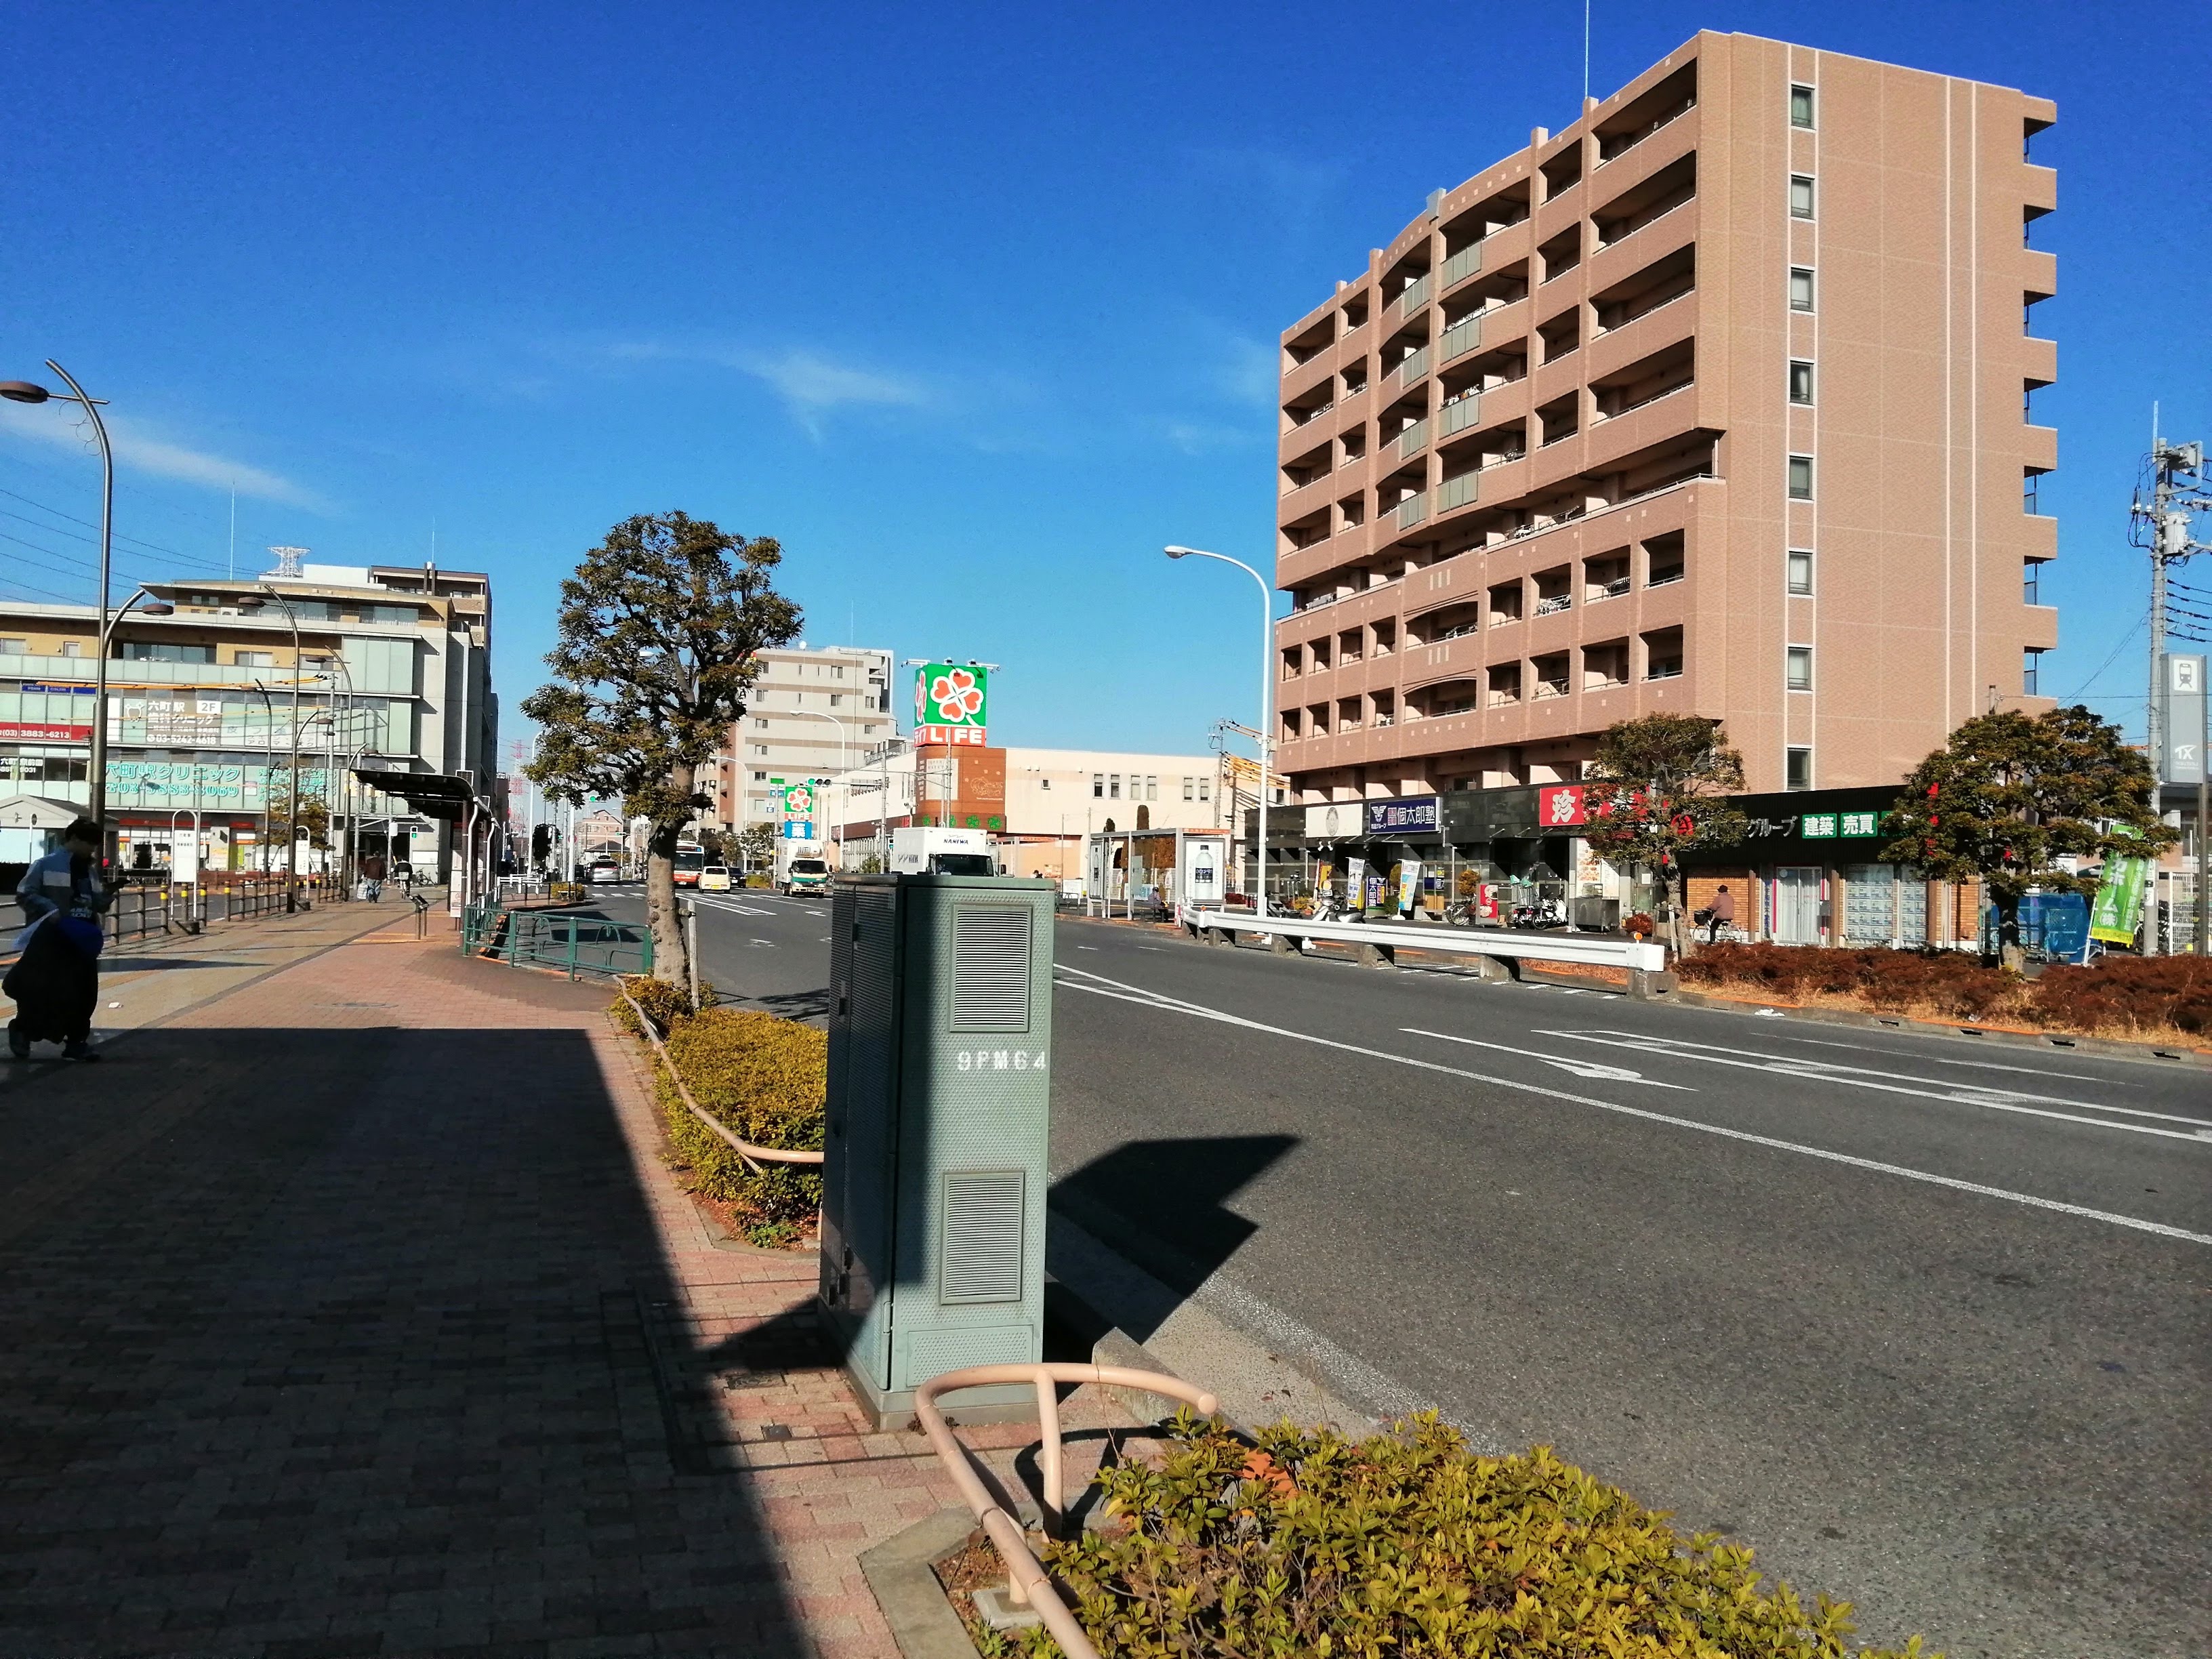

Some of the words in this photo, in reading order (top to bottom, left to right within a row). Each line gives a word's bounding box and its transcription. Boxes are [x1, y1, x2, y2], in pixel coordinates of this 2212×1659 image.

[201, 703, 216, 711] 2F
[930, 727, 982, 743] LIFE
[2175, 745, 2197, 760] TX
[1397, 805, 1435, 825] 個太郎塾
[1804, 816, 1834, 836] 建築
[1843, 814, 1874, 835] 売買
